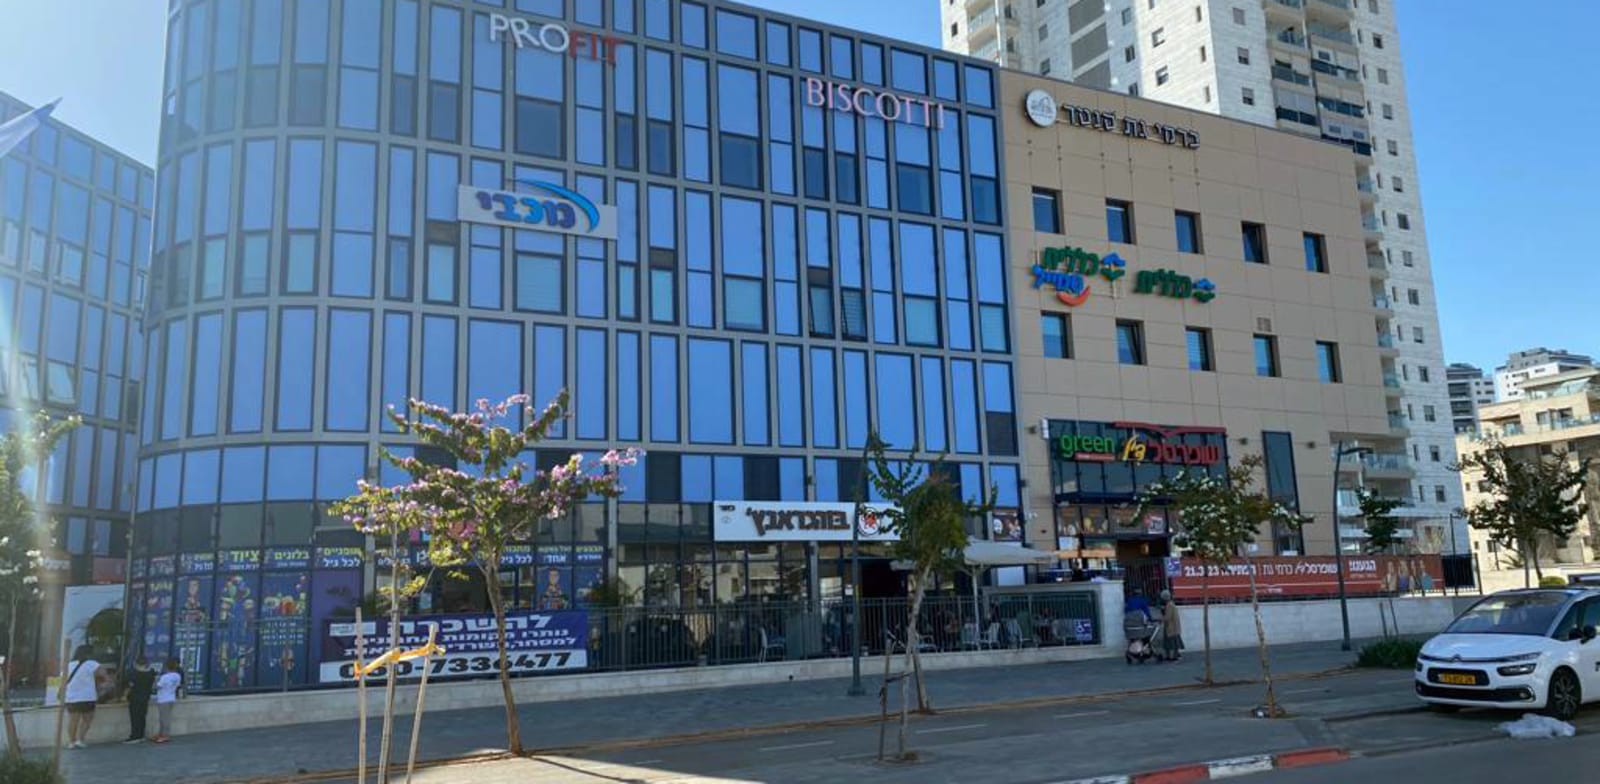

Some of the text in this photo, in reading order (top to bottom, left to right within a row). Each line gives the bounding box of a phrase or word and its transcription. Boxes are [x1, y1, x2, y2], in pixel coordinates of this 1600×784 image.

[489, 12, 624, 65] PROFIT
[806, 77, 945, 129] BISCOTTI
[1061, 103, 1117, 131] סנטר
[1123, 116, 1150, 138] גת
[1154, 122, 1201, 149] כרמי
[475, 191, 577, 229] מכבי
[1043, 246, 1100, 276] כללית
[1135, 268, 1193, 299] כללית
[1060, 433, 1116, 458] green
[1150, 440, 1219, 464] שופרסל
[230, 550, 260, 563] ציוד
[342, 557, 361, 568] לכל
[1184, 565, 1219, 577] 21.323
[521, 629, 570, 638] נותרו
